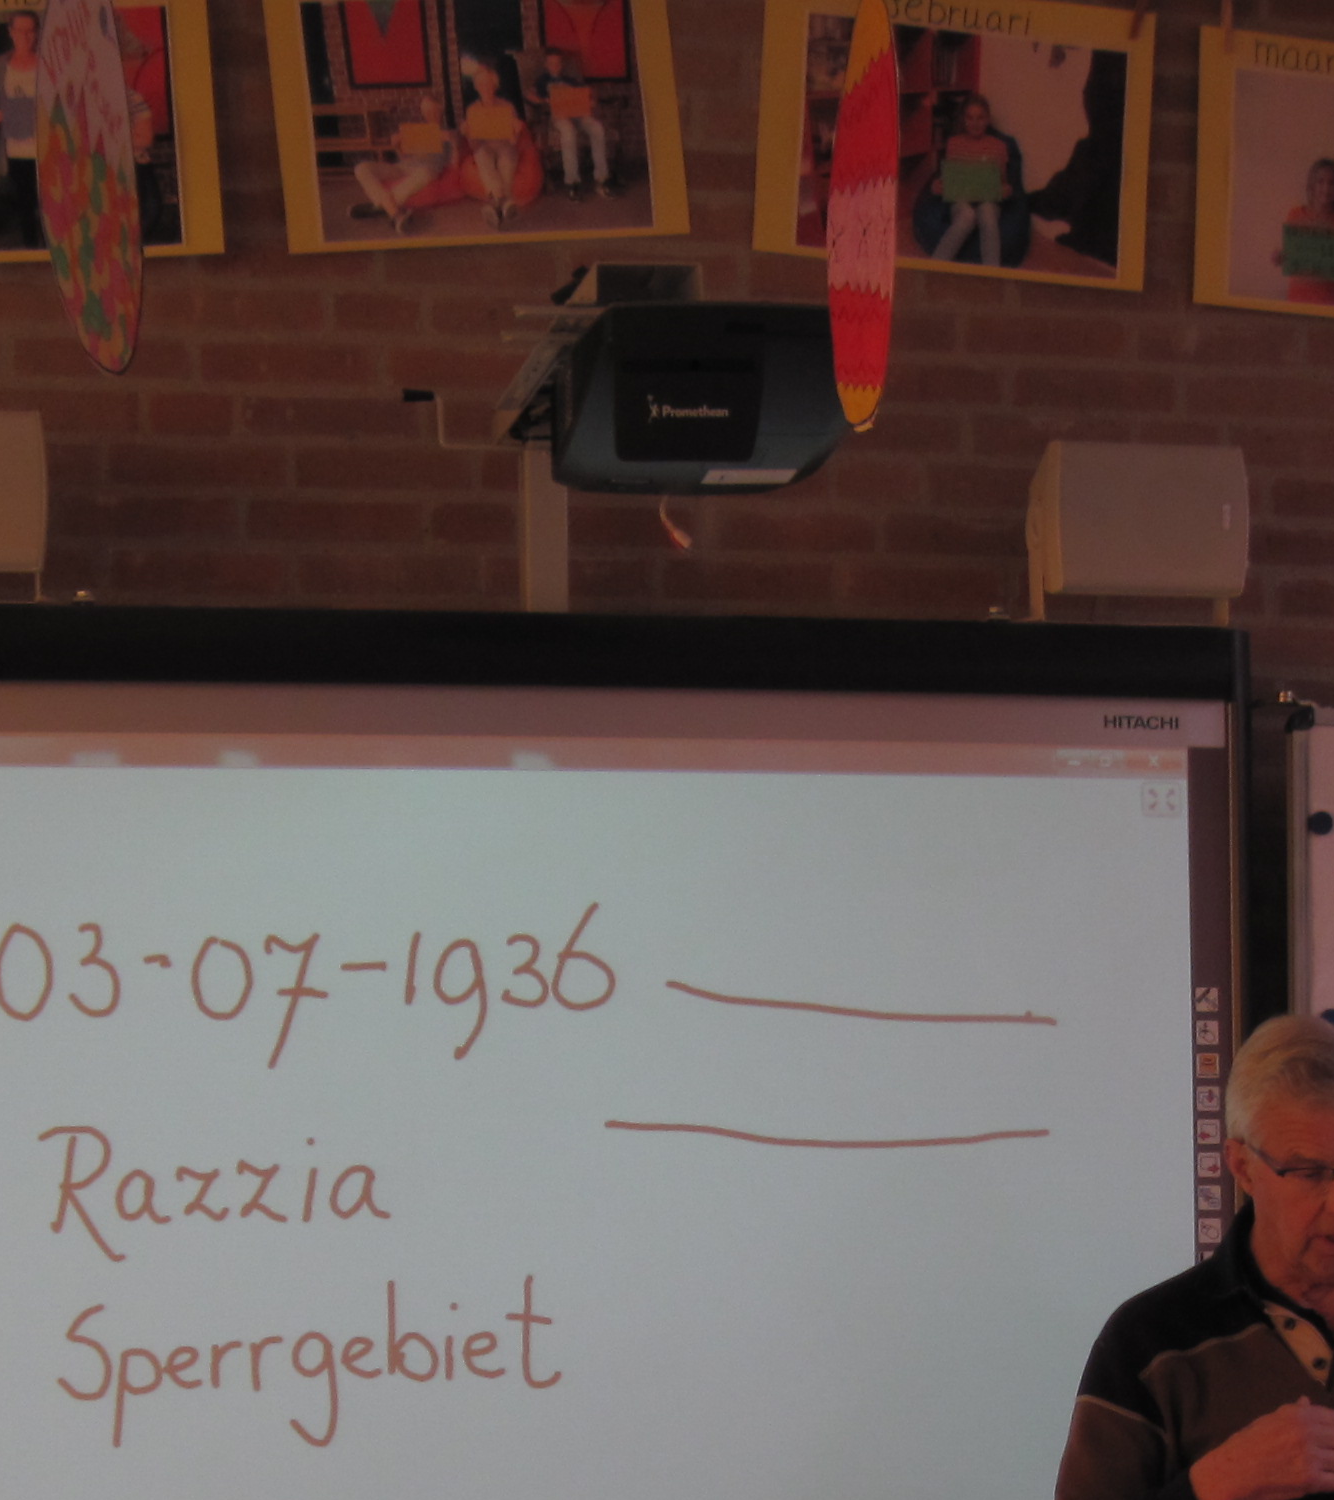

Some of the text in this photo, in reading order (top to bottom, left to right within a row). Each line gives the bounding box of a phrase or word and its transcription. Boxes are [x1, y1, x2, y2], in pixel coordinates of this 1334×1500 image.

[662, 403, 729, 419] Promethean
[1103, 713, 1180, 731] HITACHI
[38, 1125, 392, 1264] Razzia
[57, 1272, 564, 1450] Sperrgebiet
